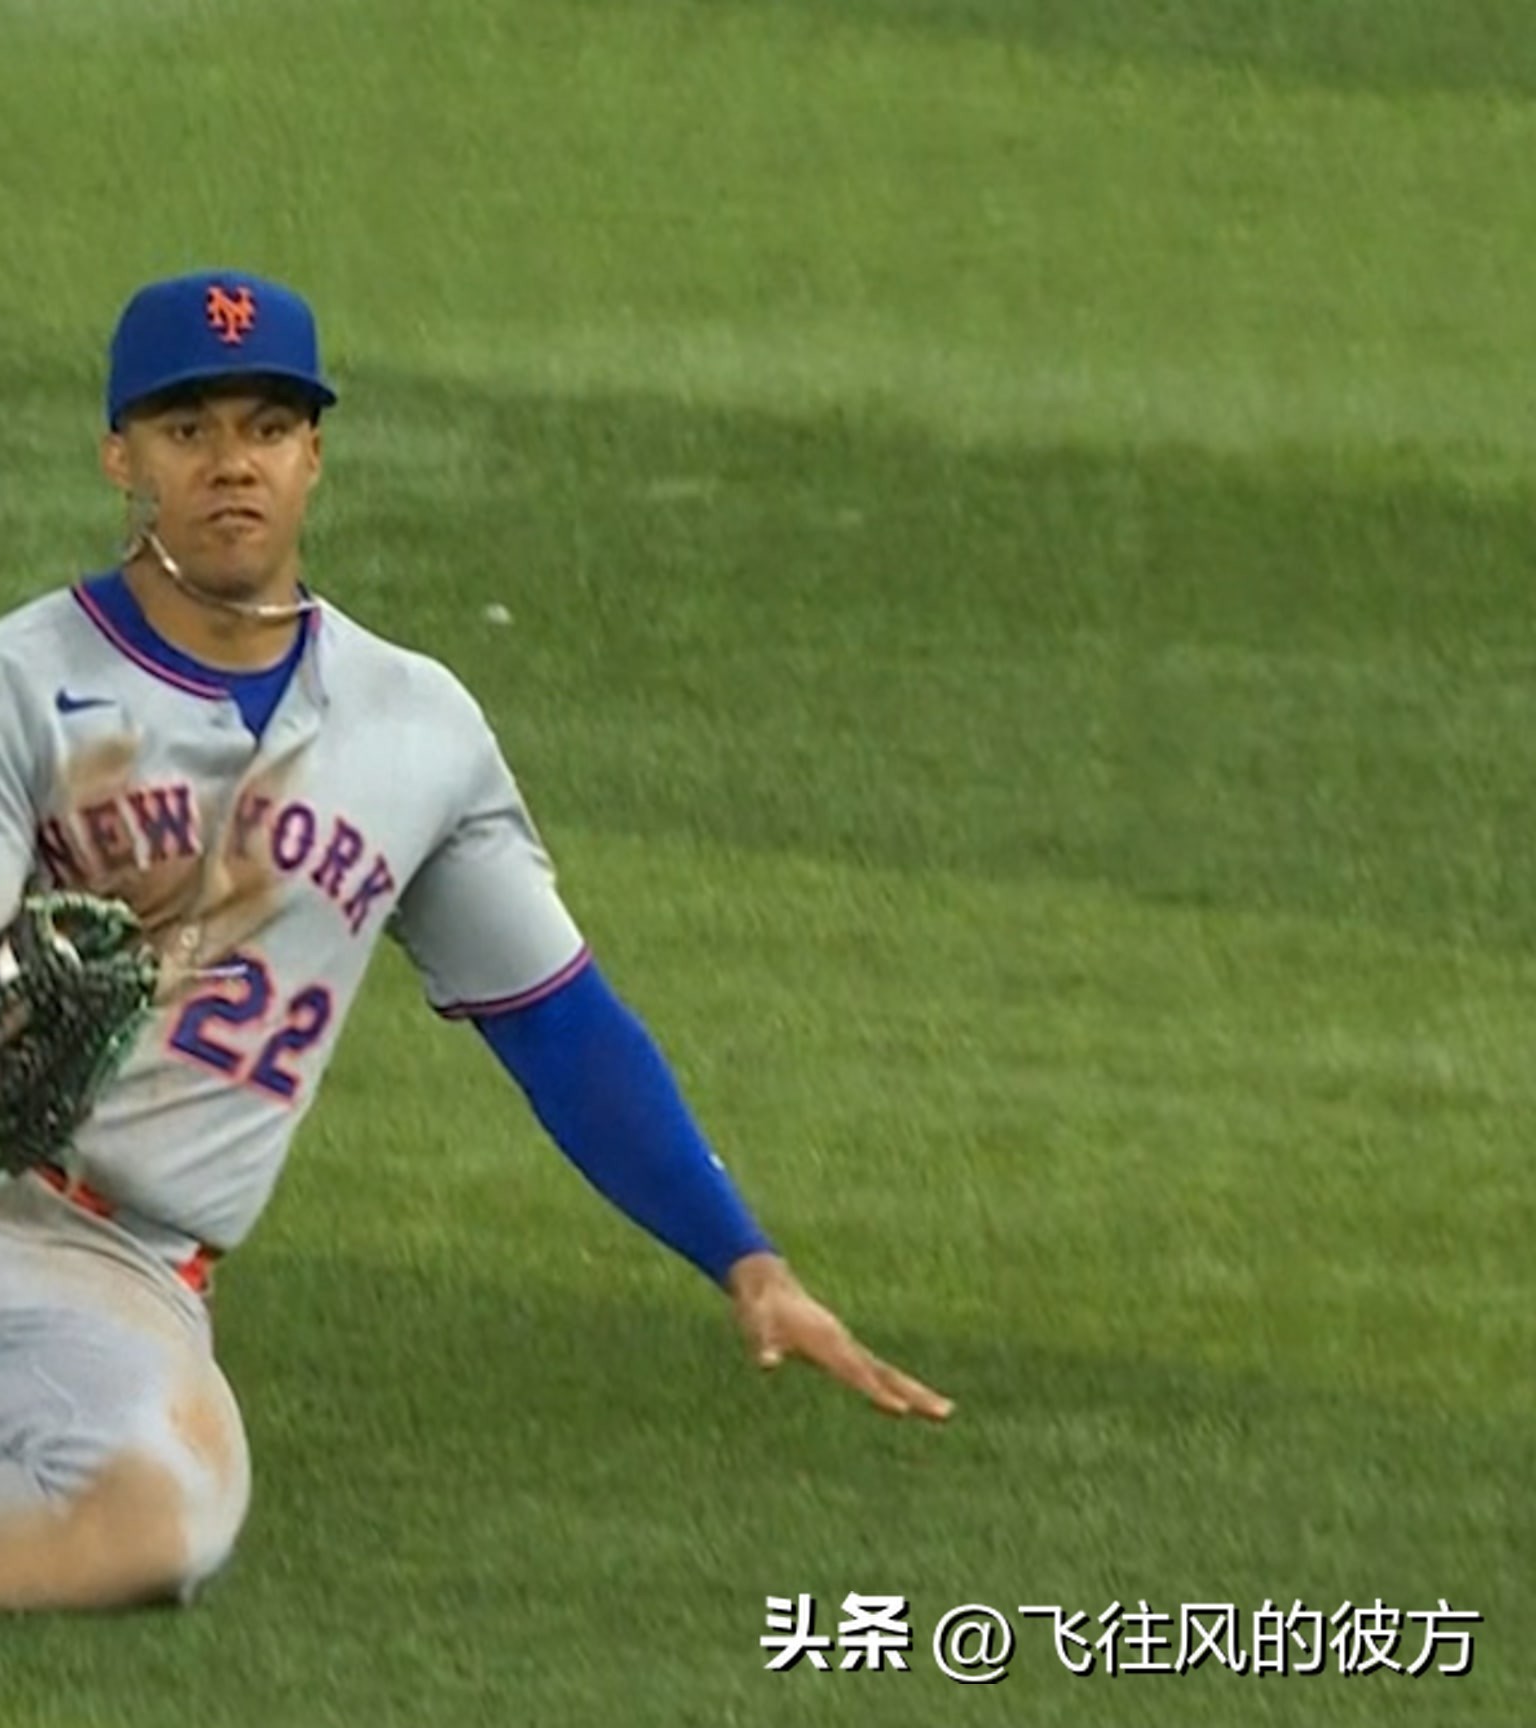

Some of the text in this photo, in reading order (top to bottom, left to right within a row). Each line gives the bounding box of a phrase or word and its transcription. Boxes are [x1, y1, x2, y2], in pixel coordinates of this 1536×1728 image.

[37, 781, 396, 937] NEW YORK
[168, 949, 336, 1104] 22
